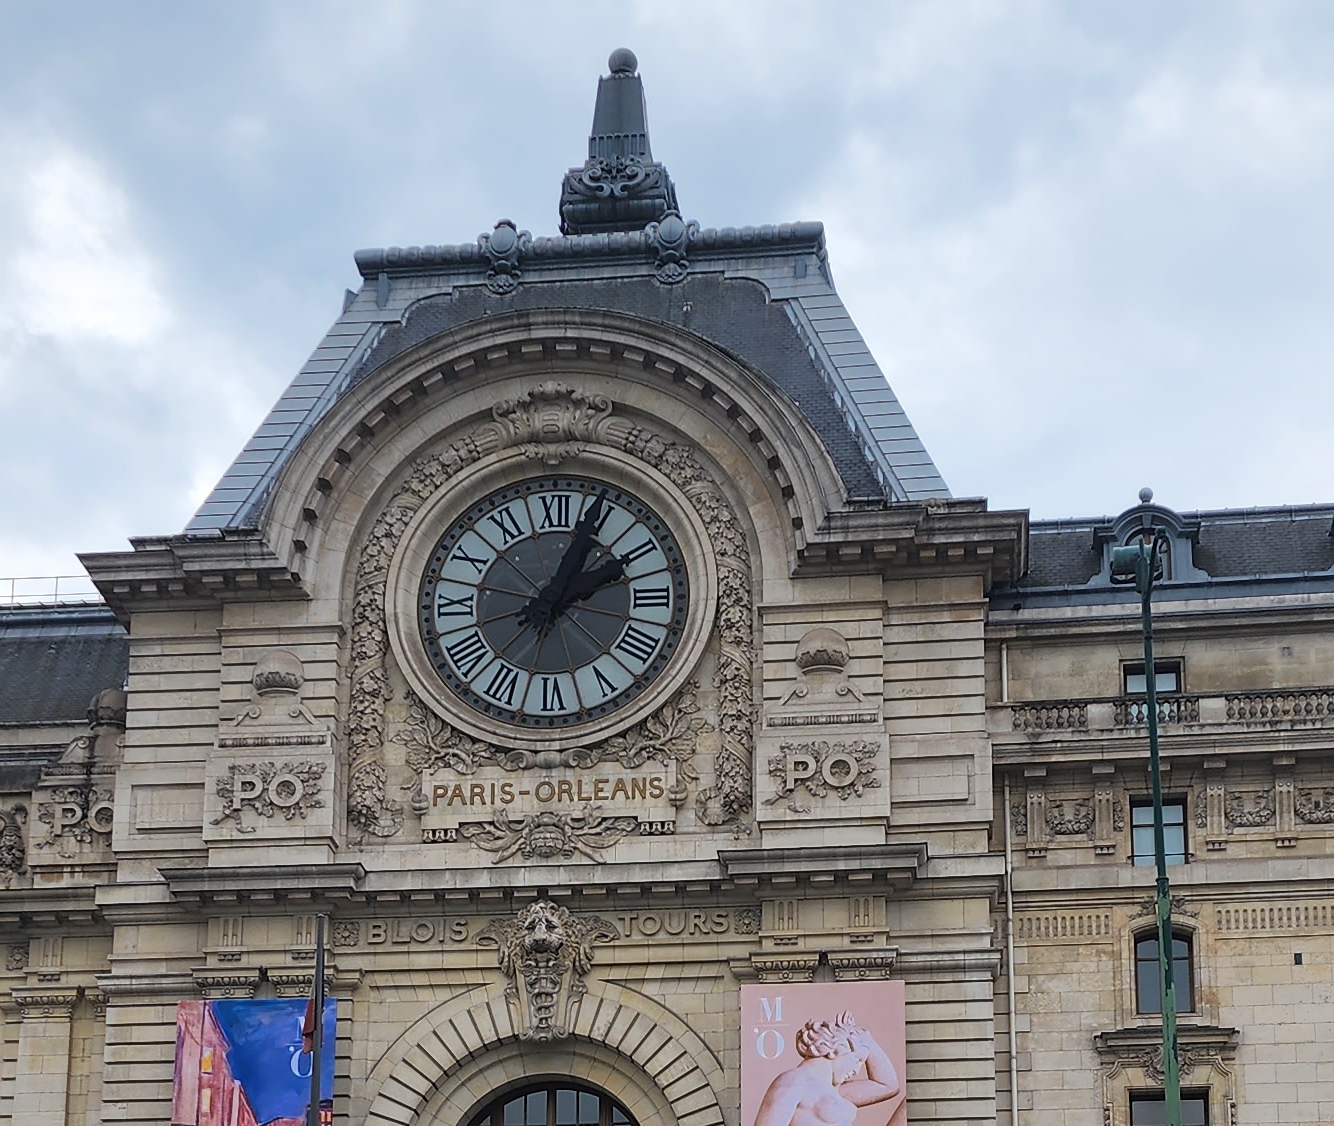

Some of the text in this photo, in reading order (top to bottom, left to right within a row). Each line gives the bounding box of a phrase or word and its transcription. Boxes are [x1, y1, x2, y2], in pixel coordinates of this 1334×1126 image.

[487, 506, 525, 545] XI
[539, 495, 571, 529] XII
[450, 545, 489, 574] X
[438, 594, 474, 618] IX
[633, 586, 669, 609] III
[446, 630, 489, 678] VIII
[483, 663, 519, 706] VII
[541, 677, 566, 711] VI
[592, 665, 618, 698] V
[786, 752, 859, 791] PO
[233, 774, 304, 810] PO
[432, 776, 665, 807] PARIS-ORLEANS
[54, 801, 114, 836] PO
[367, 909, 730, 944] BLOIS TOURS
[760, 996, 784, 1022] M
